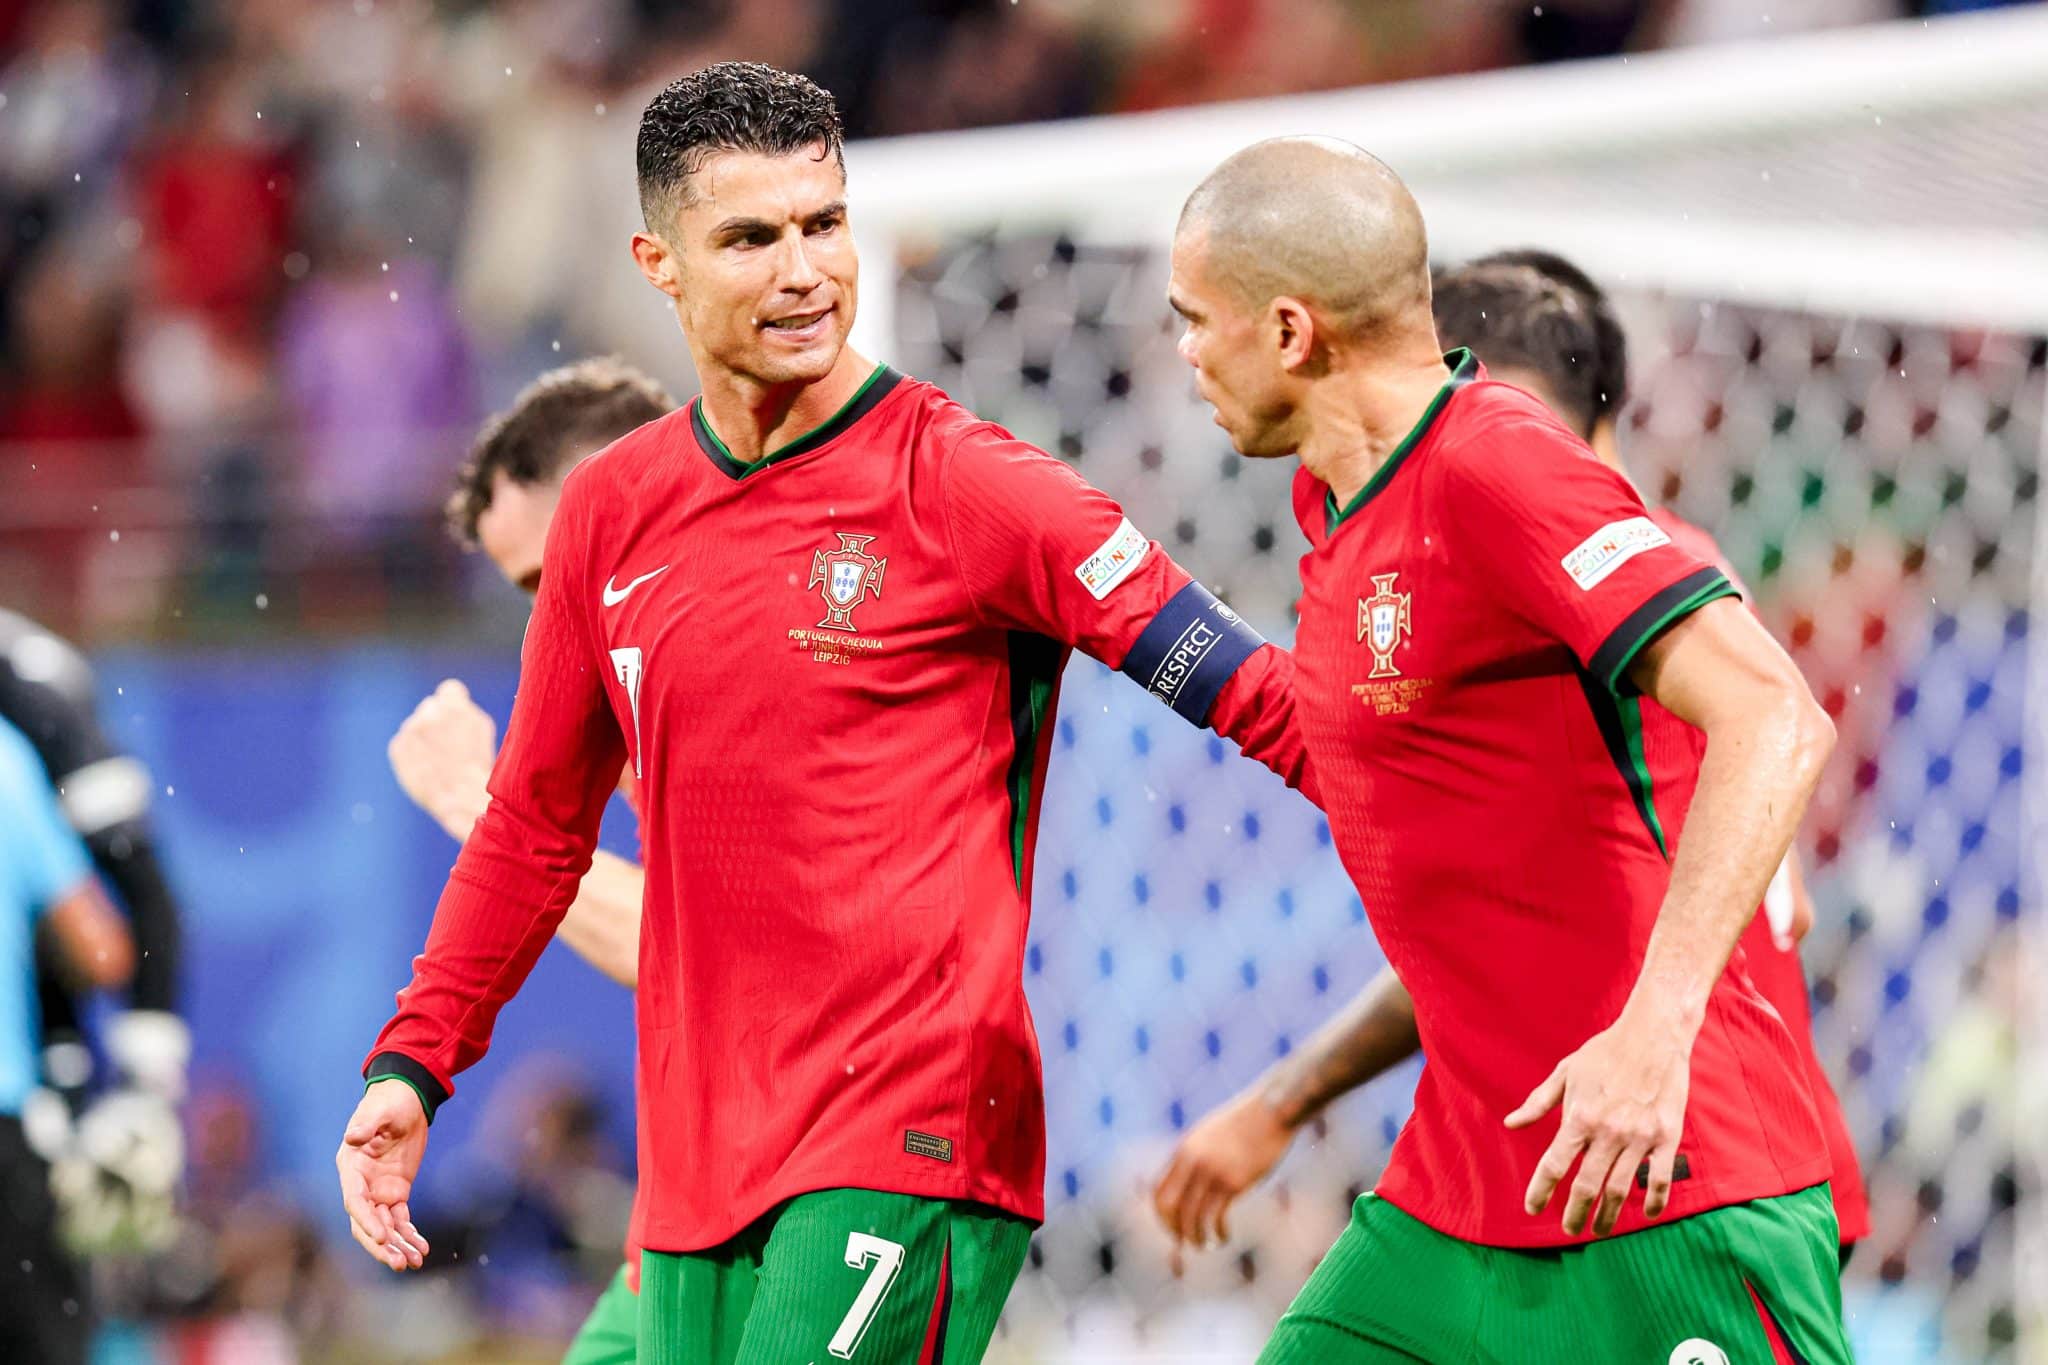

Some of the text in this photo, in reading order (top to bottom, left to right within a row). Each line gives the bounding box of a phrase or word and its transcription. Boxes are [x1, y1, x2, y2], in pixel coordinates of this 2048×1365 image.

[1080, 556, 1101, 577] UEFA
[788, 629, 883, 649] PORTUGAL/CHEQUIA
[811, 641, 840, 654] JUNHO
[814, 651, 850, 665] LEIPZIG
[1156, 622, 1215, 695] RESPECT
[608, 647, 642, 780] 7
[827, 1231, 905, 1360] 7
